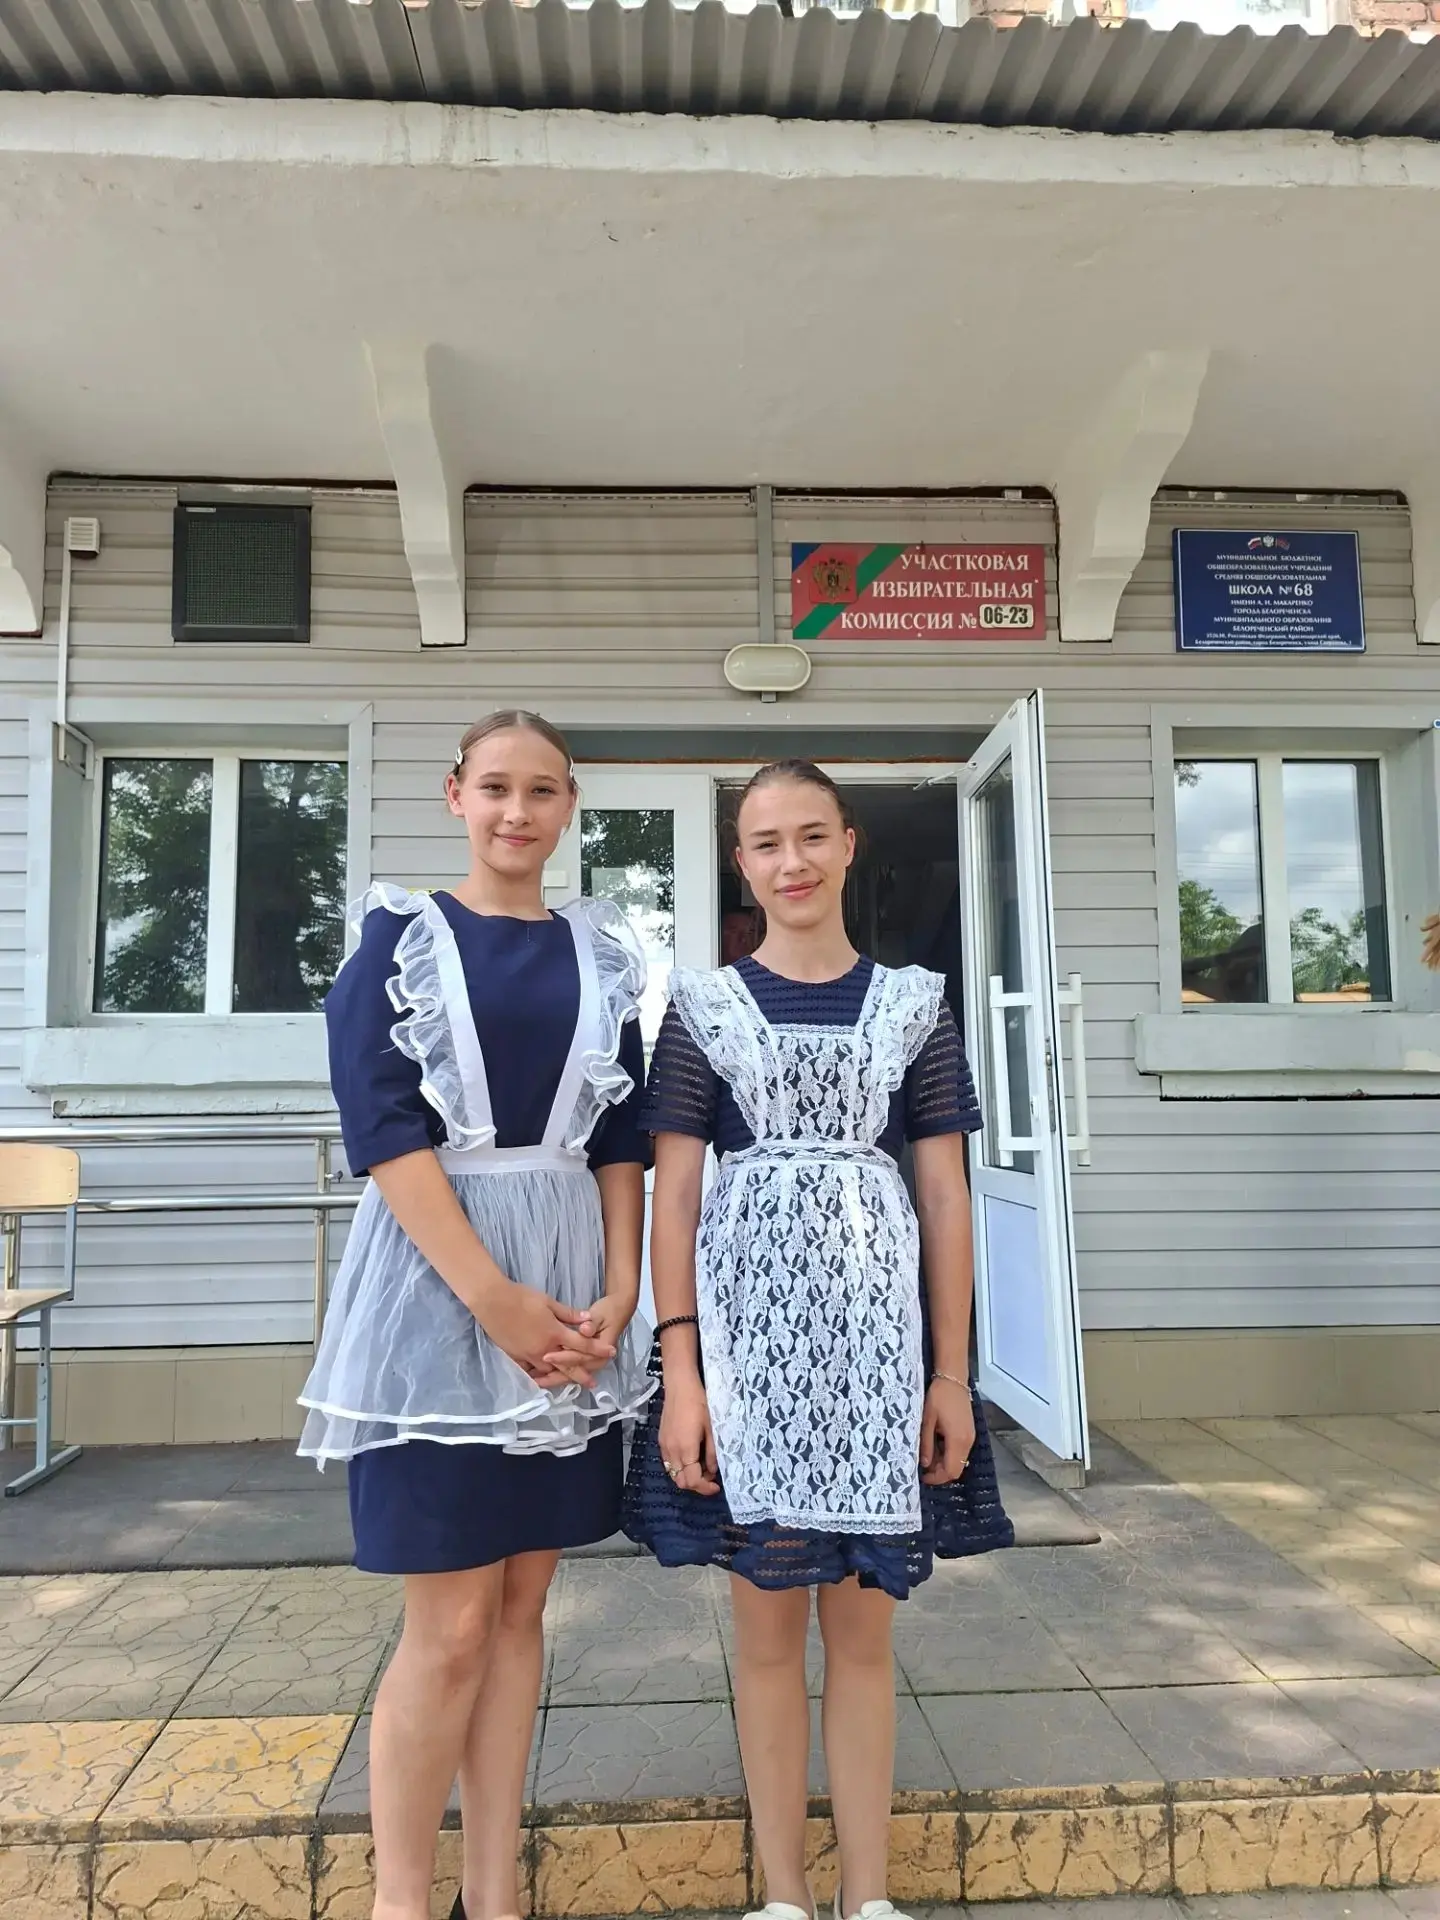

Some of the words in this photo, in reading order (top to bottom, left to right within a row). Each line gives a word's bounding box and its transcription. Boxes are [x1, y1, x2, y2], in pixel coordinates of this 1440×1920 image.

[899, 553, 1029, 571] УЧАСТКОВАЯ
[871, 581, 1034, 598] ИЗБИРАТЕЛЬНАЯ
[1229, 585, 1273, 595] ШКОЛА
[841, 612, 953, 630] КОМИССИЯ
[958, 613, 977, 629] №
[983, 606, 1029, 624] 06-23
